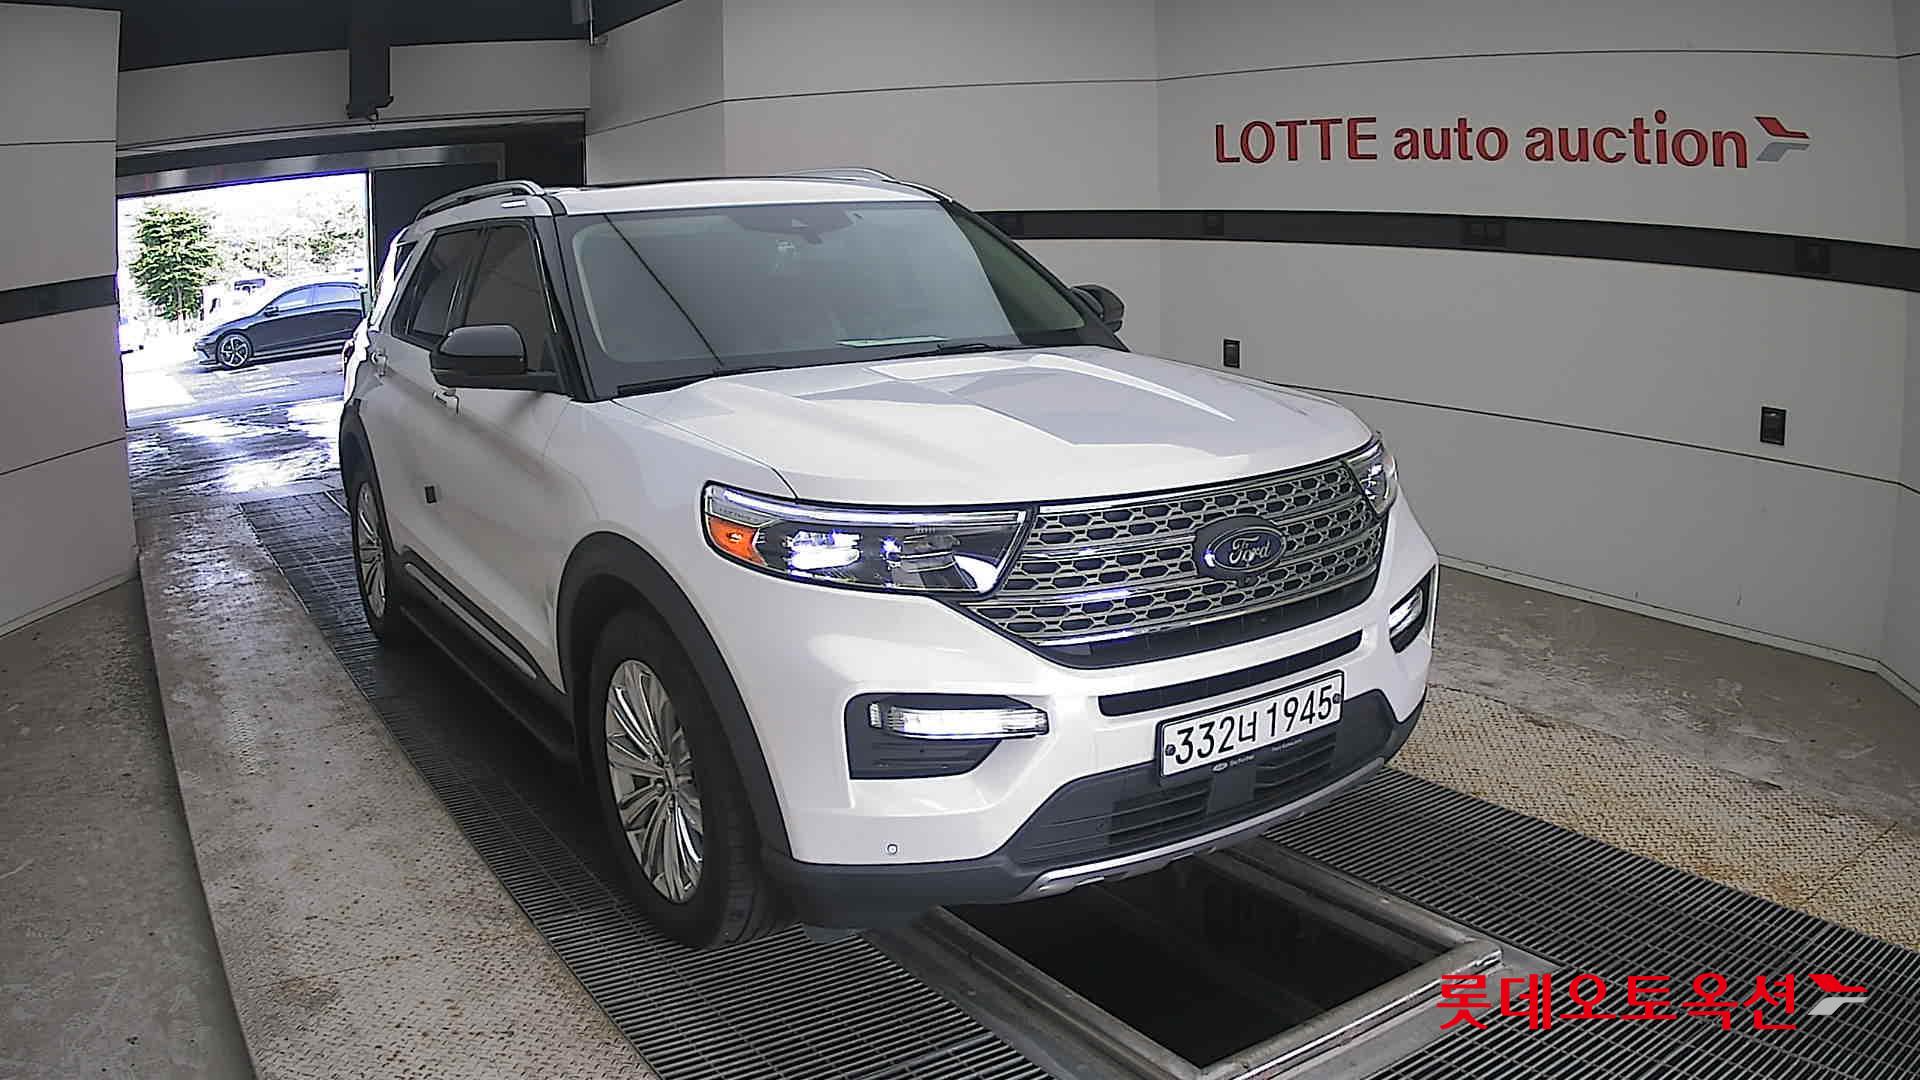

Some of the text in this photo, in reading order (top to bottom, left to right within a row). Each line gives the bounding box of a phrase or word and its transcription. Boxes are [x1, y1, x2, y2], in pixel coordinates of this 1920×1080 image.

[1215, 109, 1748, 168] LOTTE auto auction
[1229, 535, 1271, 564] Ford
